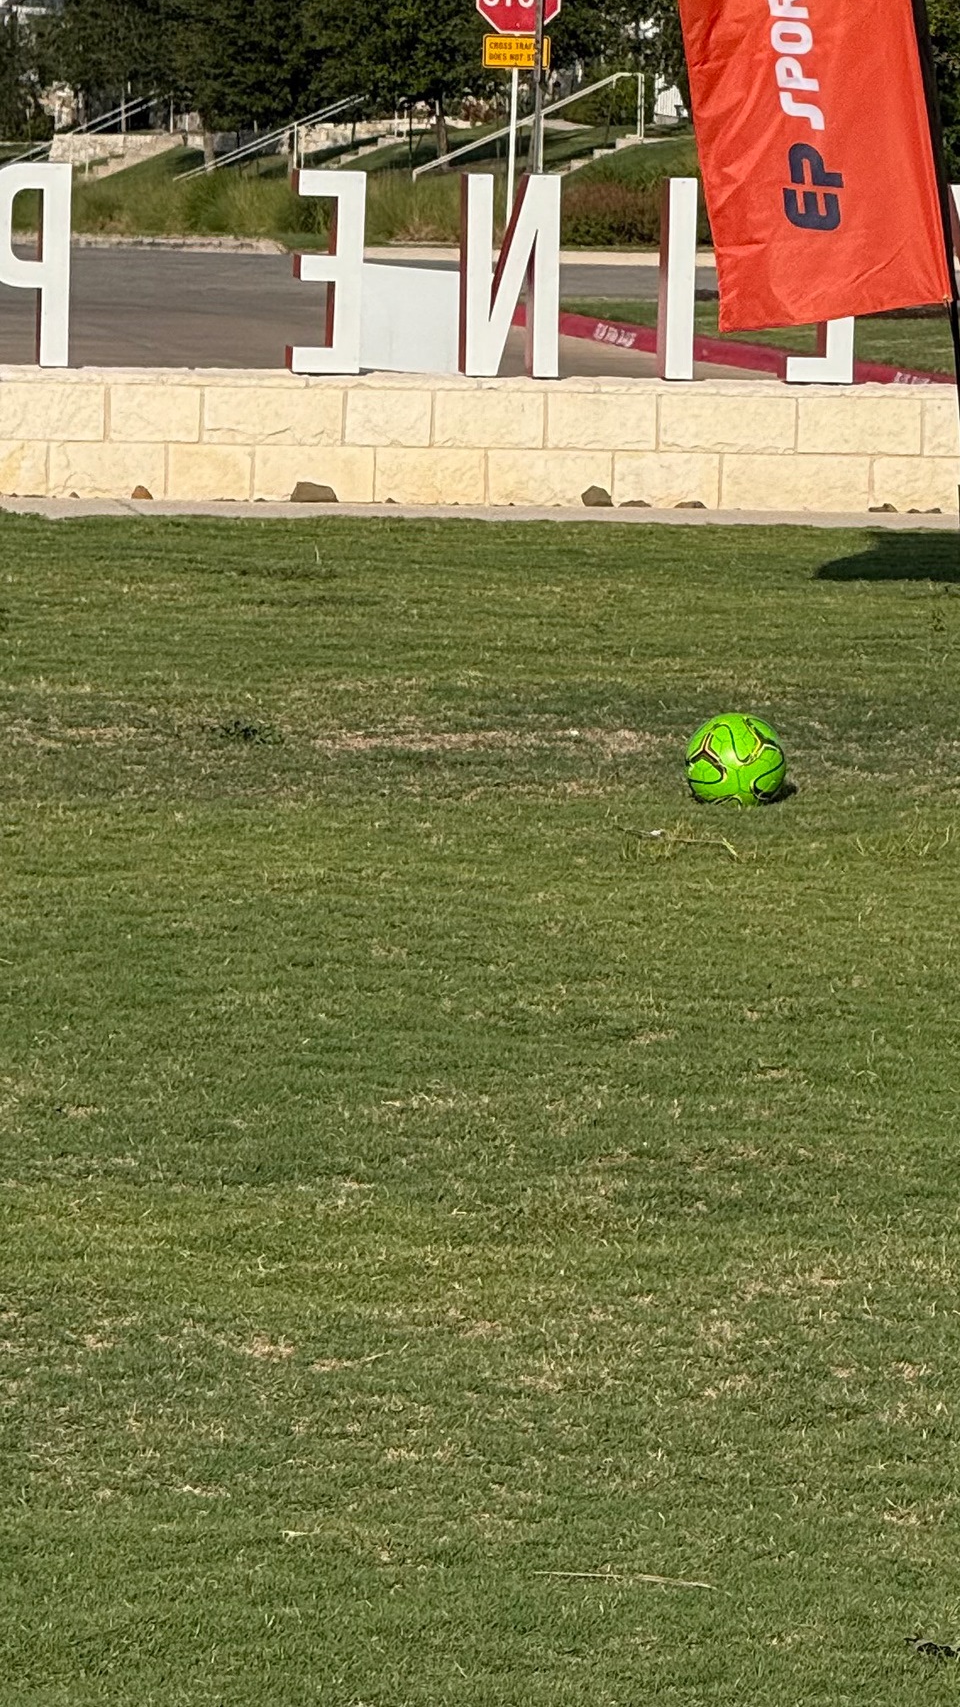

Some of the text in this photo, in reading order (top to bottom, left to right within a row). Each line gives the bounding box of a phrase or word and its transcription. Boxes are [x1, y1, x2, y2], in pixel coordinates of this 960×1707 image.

[489, 42, 536, 50] CROSS TRAF
[488, 52, 508, 61] DOES
[510, 53, 524, 62] NOT
[783, 142, 844, 231] EP
